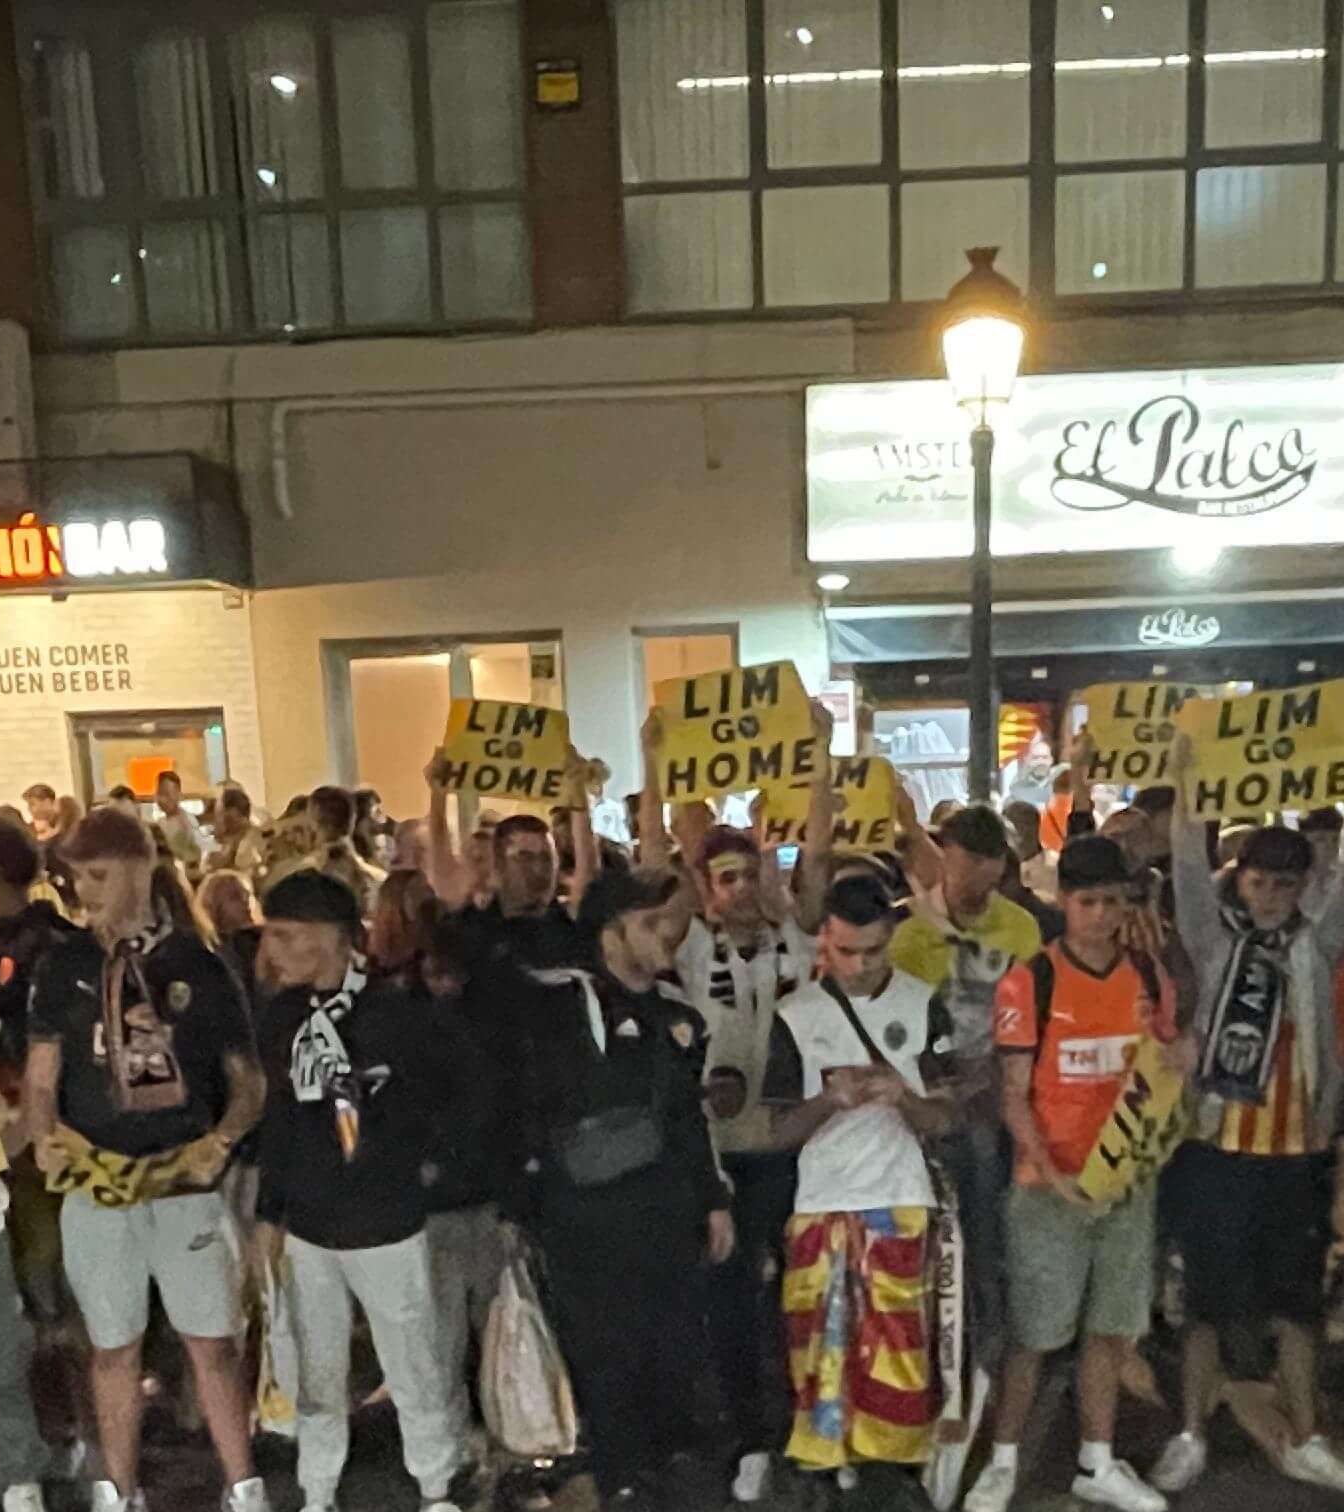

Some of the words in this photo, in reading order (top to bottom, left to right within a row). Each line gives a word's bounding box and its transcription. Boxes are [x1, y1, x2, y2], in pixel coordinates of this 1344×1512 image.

[1054, 420, 1118, 479] El
[1128, 394, 1318, 490] Palco
[48, 642, 131, 666] COMER
[51, 667, 133, 692] BEBER
[685, 665, 780, 720] LIM
[466, 700, 549, 739] LIM
[711, 715, 760, 744] GO
[1217, 688, 1322, 740] LIM
[1133, 721, 1175, 744] GO
[484, 739, 524, 760] GO
[1243, 735, 1296, 765] GO
[439, 761, 564, 798] HOME
[666, 737, 817, 797] HOME
